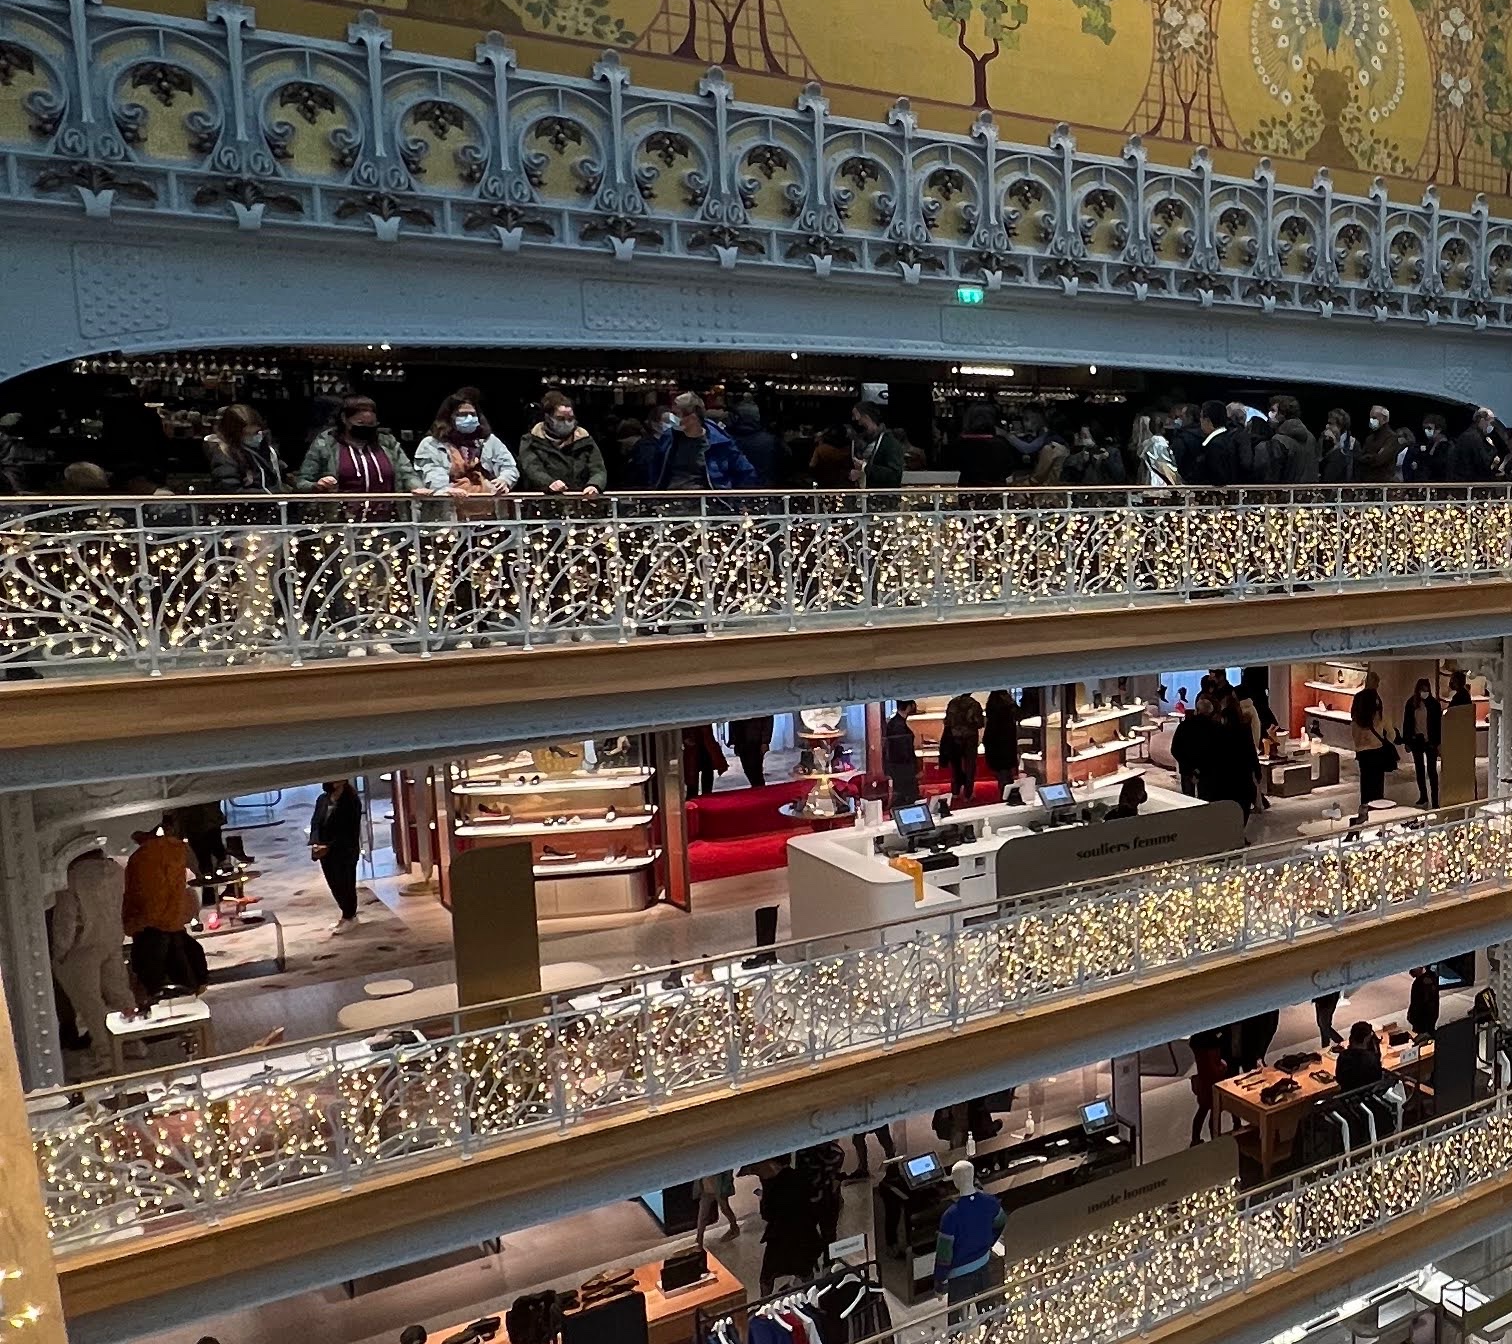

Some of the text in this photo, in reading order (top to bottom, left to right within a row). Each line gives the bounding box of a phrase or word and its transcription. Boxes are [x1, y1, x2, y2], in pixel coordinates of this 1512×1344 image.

[1075, 832, 1178, 859] souliers femme
[1087, 1193, 1121, 1215] mode
